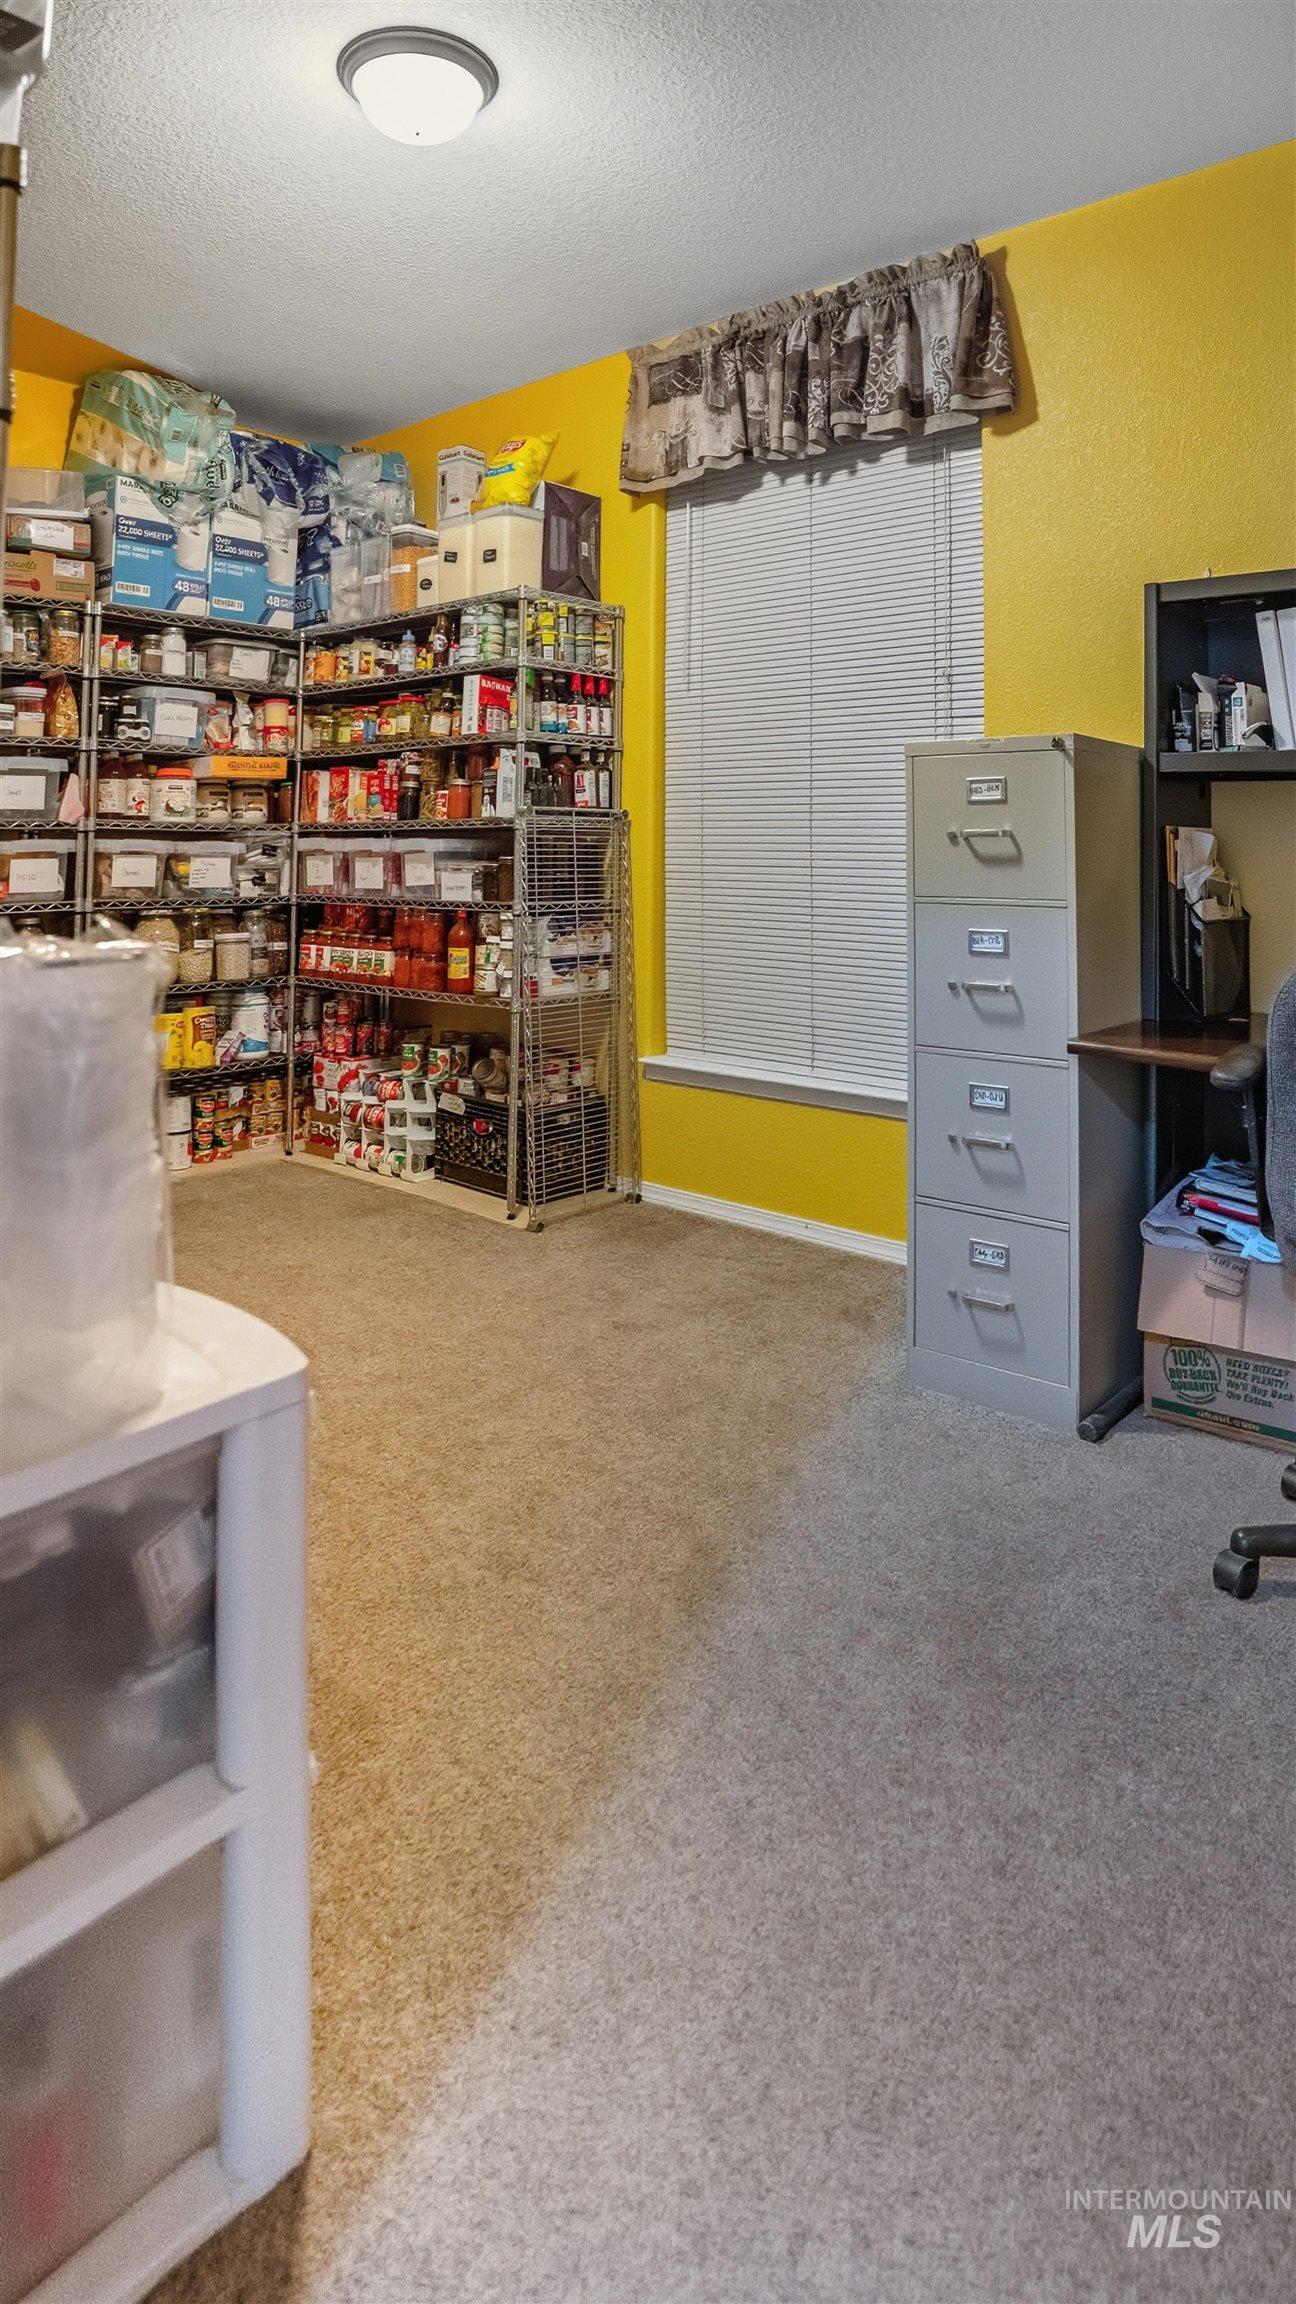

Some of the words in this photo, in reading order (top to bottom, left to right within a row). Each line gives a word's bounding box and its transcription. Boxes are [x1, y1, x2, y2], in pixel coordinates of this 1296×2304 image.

[118, 516, 137, 526] Over
[215, 536, 232, 545] Over
[174, 580, 190, 592] 48
[266, 594, 280, 607] 48
[1170, 1348, 1211, 1368] 100%
[1226, 1358, 1251, 1371] NEED
[1226, 1368, 1249, 1382] TAKE
[1226, 1379, 1249, 1391] We'll
[1271, 1389, 1295, 1402] Back
